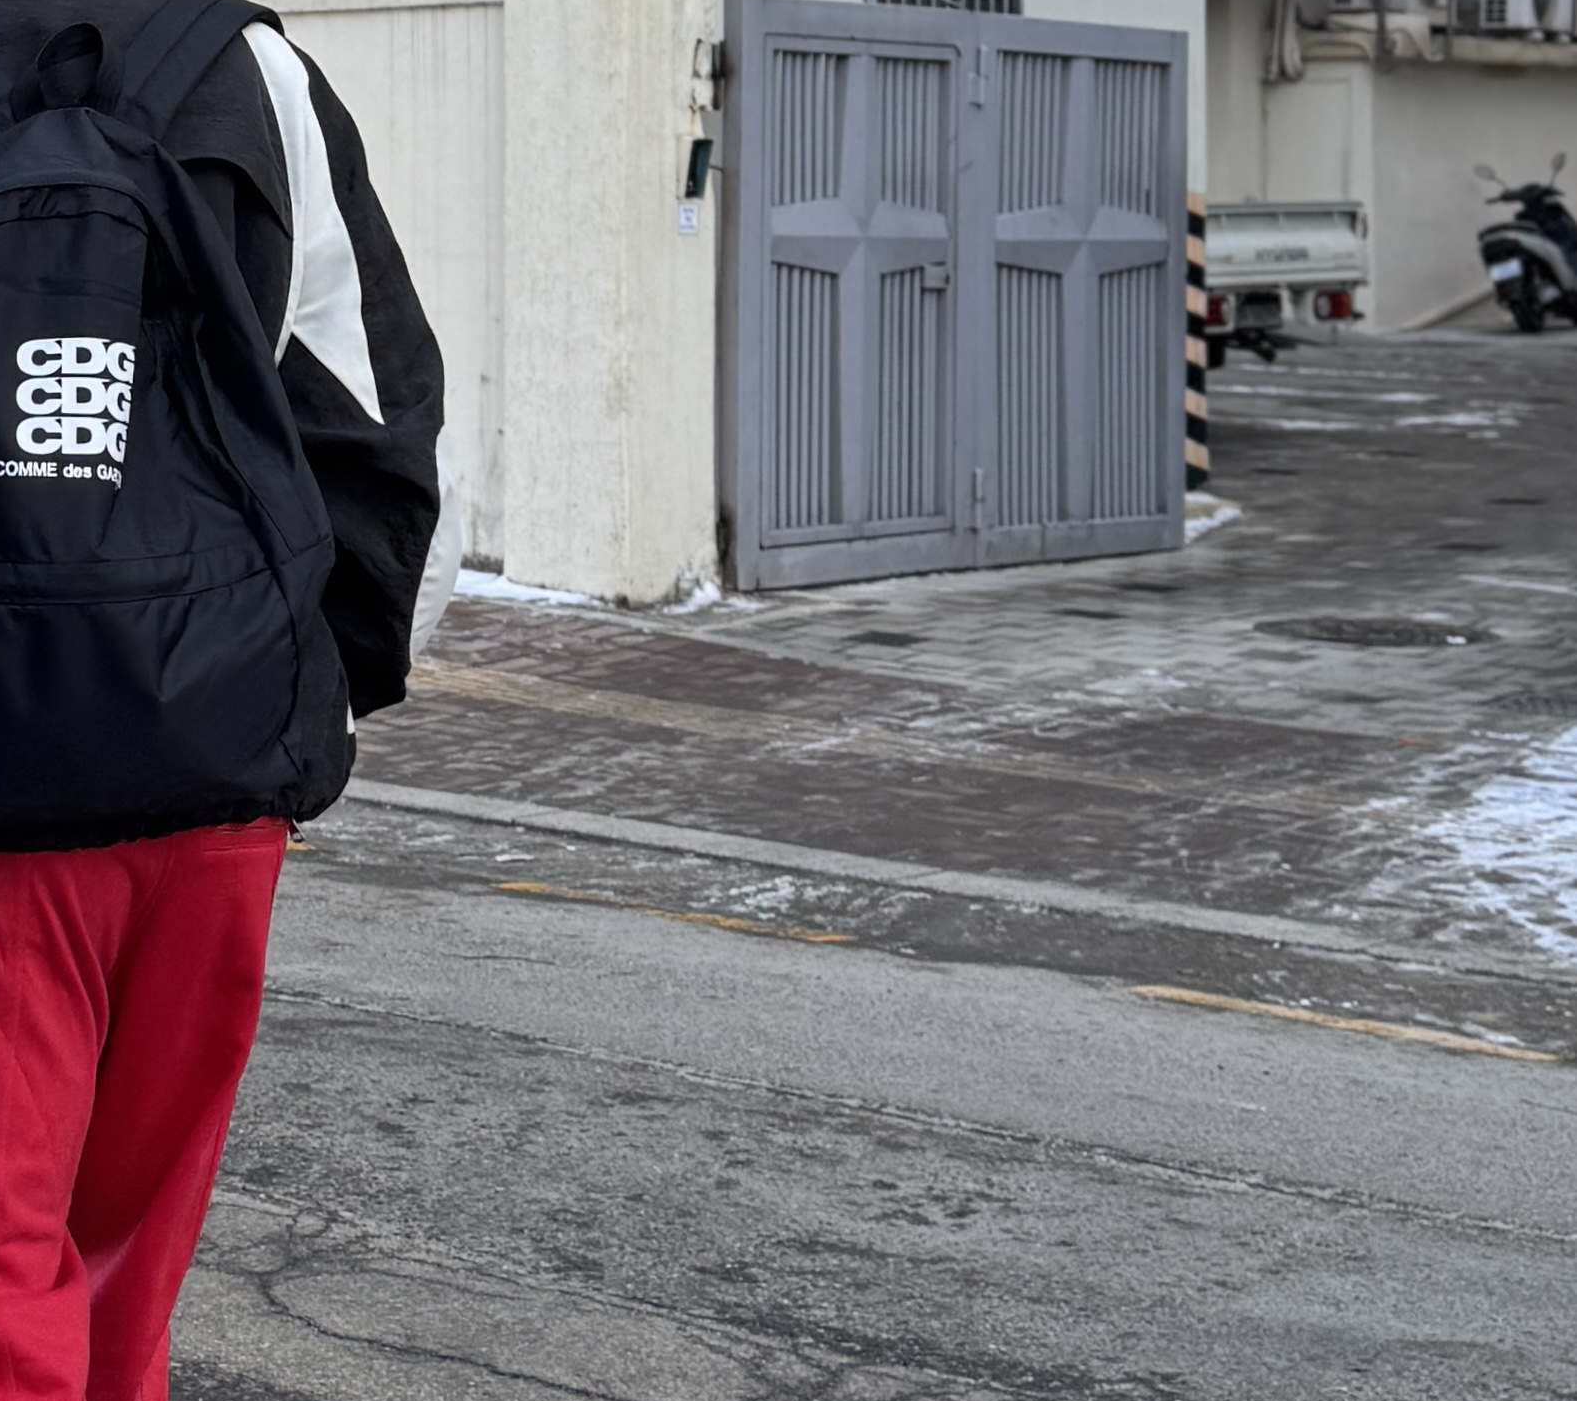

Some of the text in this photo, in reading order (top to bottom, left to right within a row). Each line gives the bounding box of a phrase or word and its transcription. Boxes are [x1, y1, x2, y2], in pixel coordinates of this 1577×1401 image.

[16, 337, 136, 384] CDG
[15, 376, 132, 424] CDG
[15, 416, 128, 464] CDG
[62, 463, 93, 479] des
